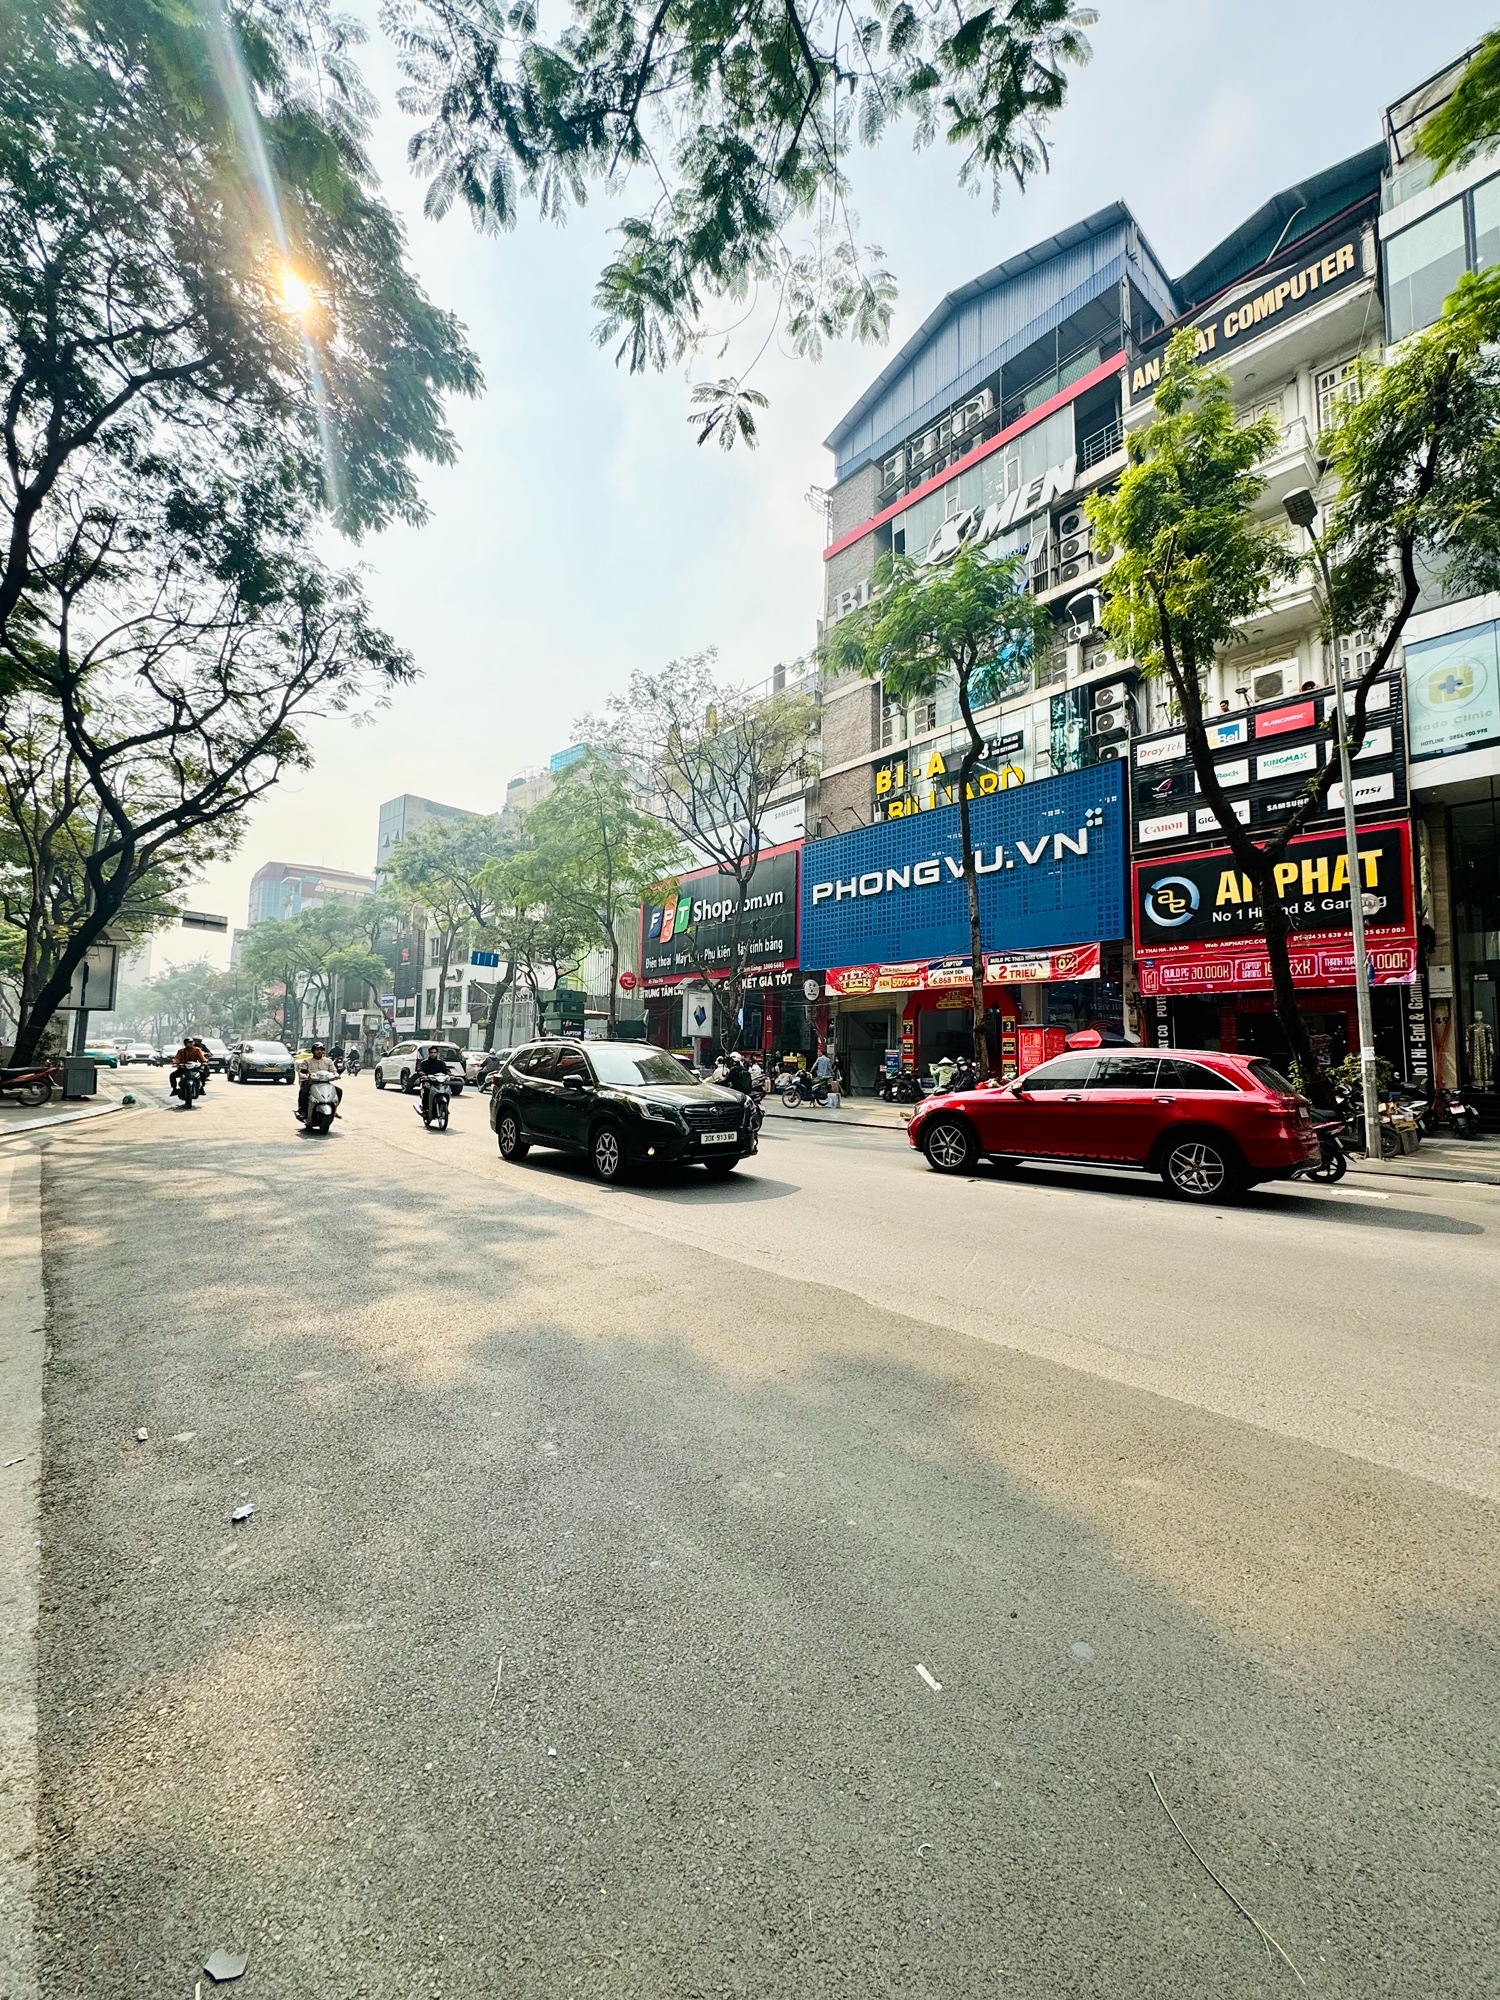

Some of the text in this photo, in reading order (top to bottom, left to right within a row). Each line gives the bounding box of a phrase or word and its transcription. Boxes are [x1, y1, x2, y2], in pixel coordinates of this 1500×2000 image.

[1132, 357, 1160, 394] AN
[1223, 243, 1355, 338] COMPUTER
[1454, 710, 1493, 724] Clinic
[1420, 737, 1445, 747] HOTLINE
[1139, 742, 1182, 759] DrayTek
[1263, 752, 1308, 767] KINGMAX
[1354, 786, 1382, 797] msi
[774, 805, 800, 819] SAMSUNG
[1198, 809, 1244, 825] GIGTE
[1144, 821, 1183, 835] Canon
[812, 827, 1088, 905] PHONGVU.VN
[1273, 848, 1383, 899] PHAT
[650, 903, 690, 934] FPT
[1212, 909, 1231, 923] No
[1236, 909, 1243, 919] 1
[1303, 901, 1316, 912] &
[645, 957, 657, 971] Điện
[658, 953, 672, 970] thoại
[704, 947, 716, 963] Phụ
[717, 944, 731, 962] kiện
[764, 935, 784, 954] bảng
[942, 960, 963, 968] LAPTOP
[741, 973, 757, 989] KẾT
[759, 972, 773, 987] GIÁ
[775, 968, 793, 985] TỐT
[998, 965, 1008, 979] 2
[661, 984, 673, 997] TÂM
[841, 978, 871, 988] TECH
